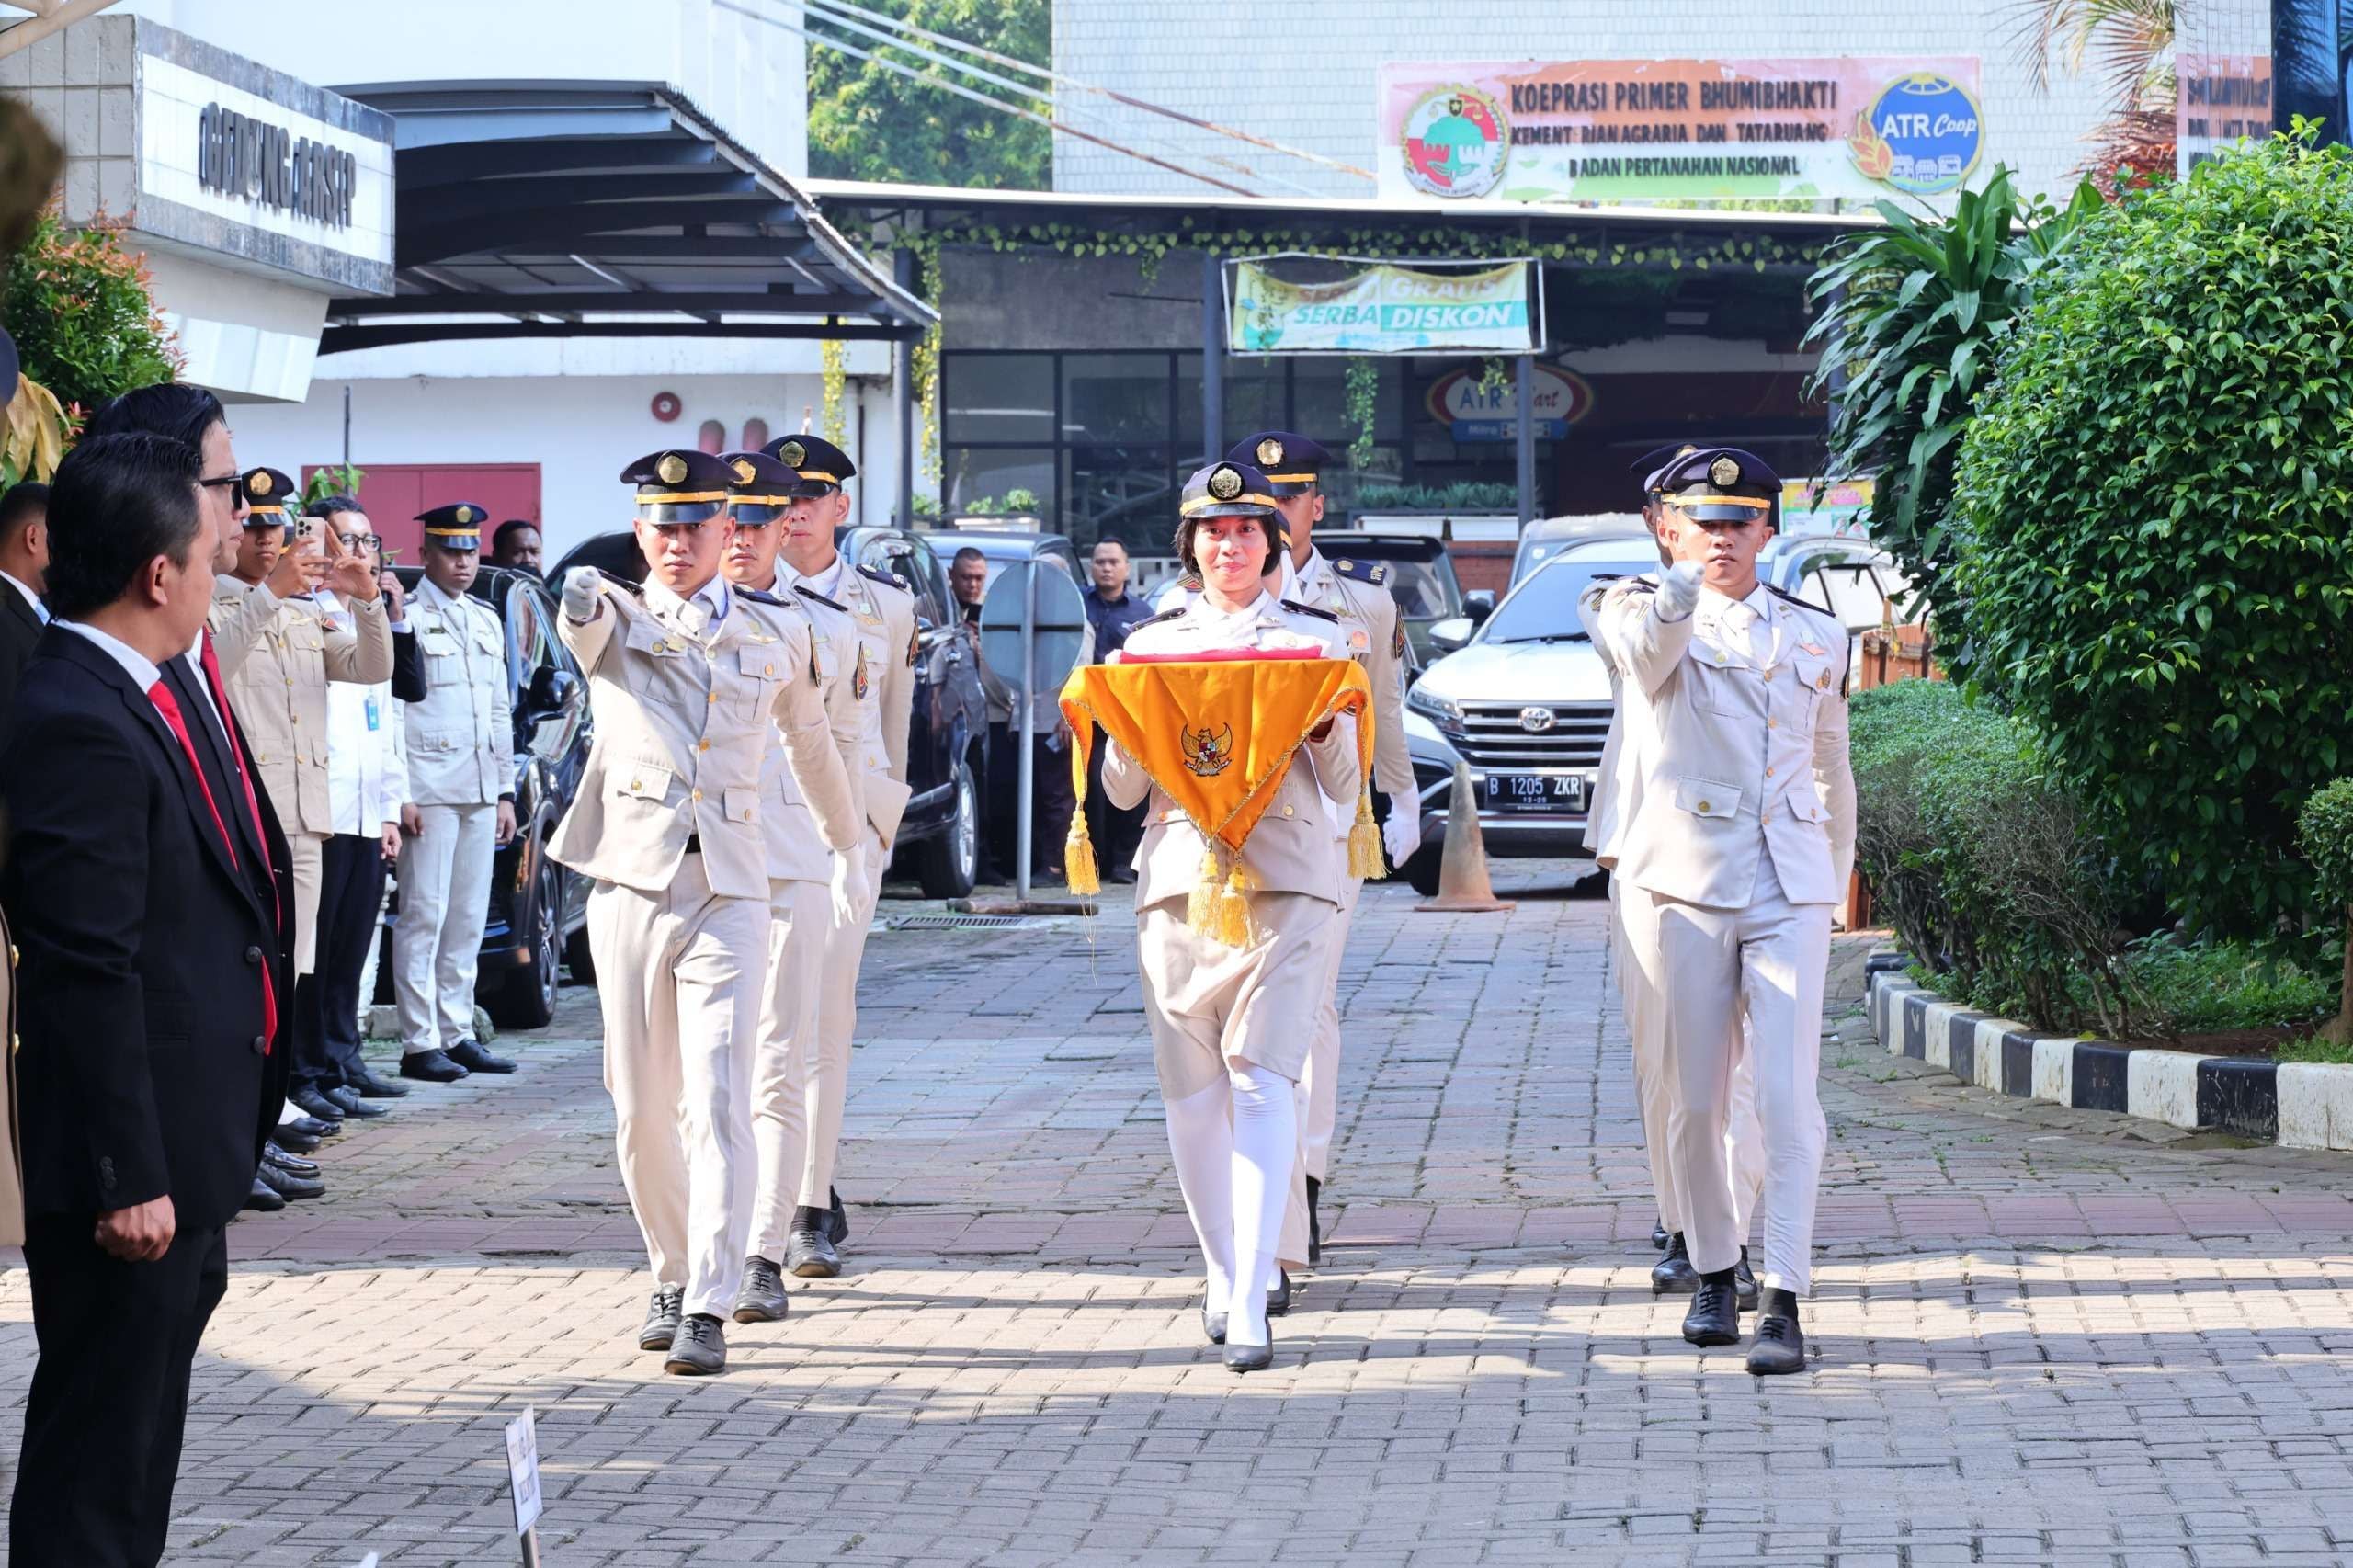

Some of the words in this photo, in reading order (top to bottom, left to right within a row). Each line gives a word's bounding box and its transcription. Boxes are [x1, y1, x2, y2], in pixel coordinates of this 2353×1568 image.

[1511, 82, 1608, 113] KOEPRASI
[1615, 81, 1688, 111] PRIMER
[1699, 80, 1837, 110] BHUMIBHAKTI
[1510, 125, 1619, 145] KEMENTRIAN
[1621, 123, 1688, 144] AGRARIA
[1696, 123, 1727, 143] DAN
[1736, 122, 1828, 143] TATARUANG
[1881, 113, 1931, 139] ATR
[1933, 112, 1978, 138] Coop
[1569, 156, 1621, 178] BADAN
[1625, 156, 1723, 177] PERTANAHAN
[1726, 154, 1802, 176] NASIONAL
[292, 135, 357, 229] ARSIP
[1294, 304, 1378, 324] SERBA
[1390, 303, 1514, 329] DISKON
[1489, 778, 1499, 795] B
[1510, 778, 1544, 795] 1205
[1553, 777, 1580, 795] ZKR
